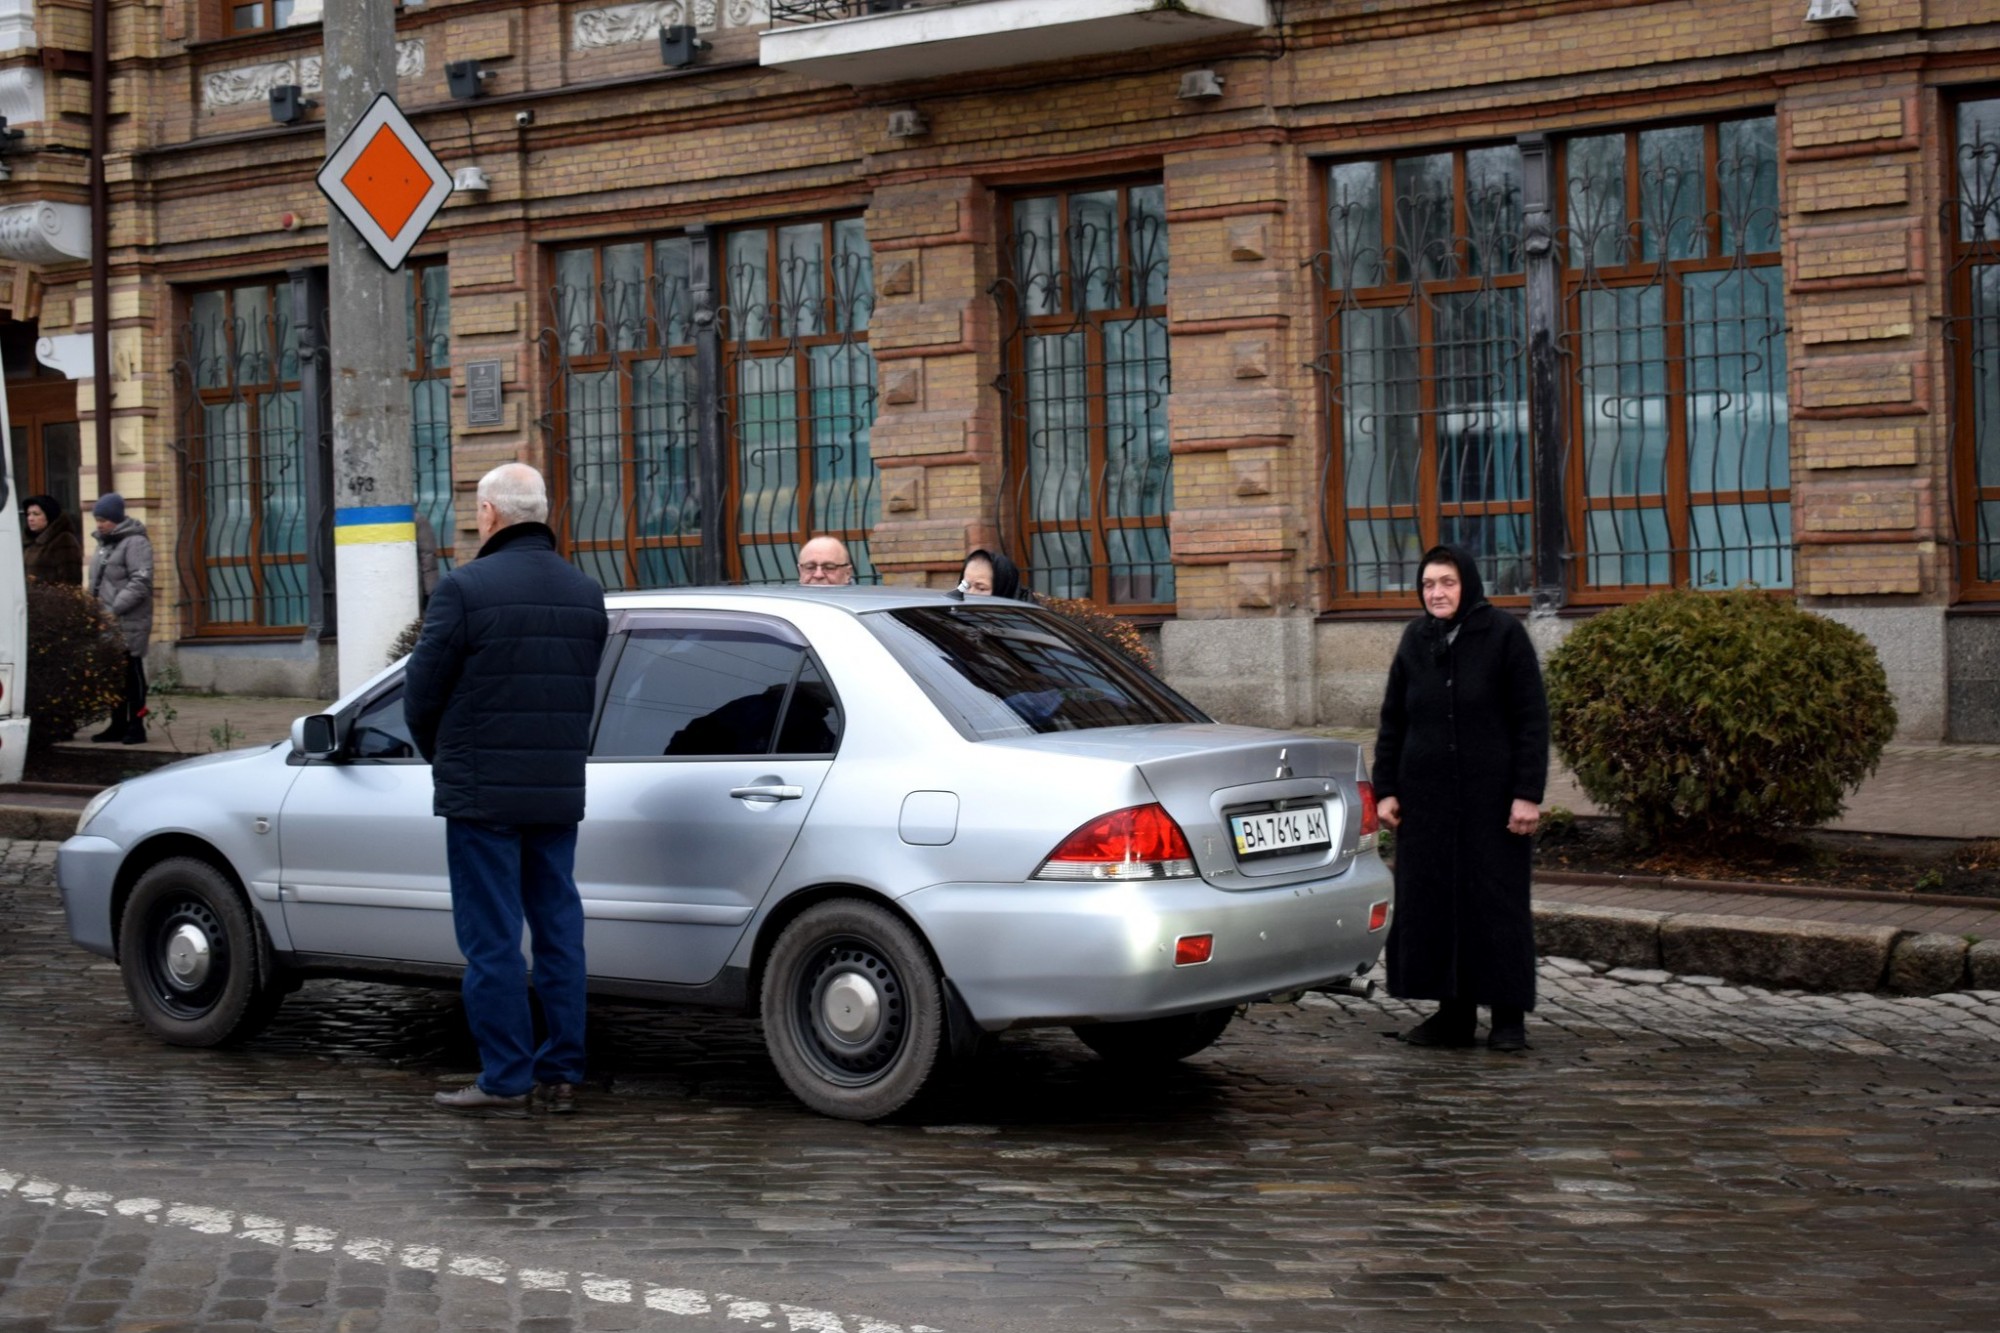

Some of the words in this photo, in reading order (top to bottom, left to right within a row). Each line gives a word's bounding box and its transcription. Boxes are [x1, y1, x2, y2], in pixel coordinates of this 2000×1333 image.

[1243, 820, 1267, 848] BA
[1266, 815, 1301, 845] 7616
[1307, 812, 1326, 840] AK
